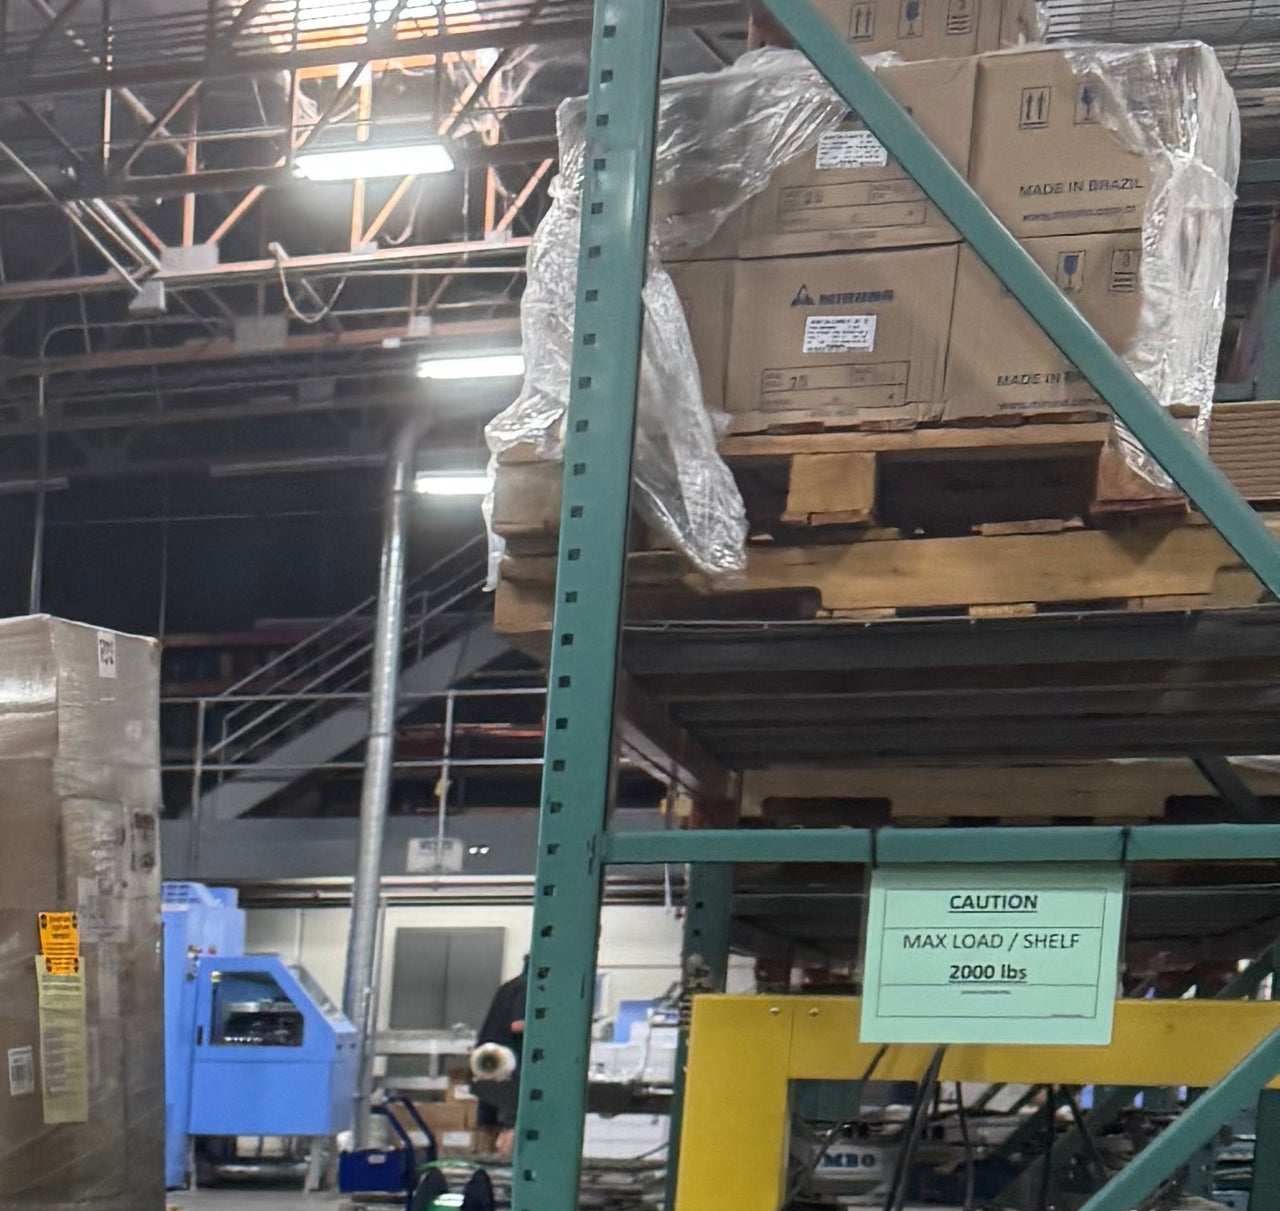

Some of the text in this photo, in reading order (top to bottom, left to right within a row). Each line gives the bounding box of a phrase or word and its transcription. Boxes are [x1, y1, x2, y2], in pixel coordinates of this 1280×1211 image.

[1068, 181, 1084, 193] IN
[948, 894, 1039, 911] CAUTION
[903, 932, 1080, 952] MAX LOAD / SHELF
[949, 964, 1028, 980] 2000 lbs
